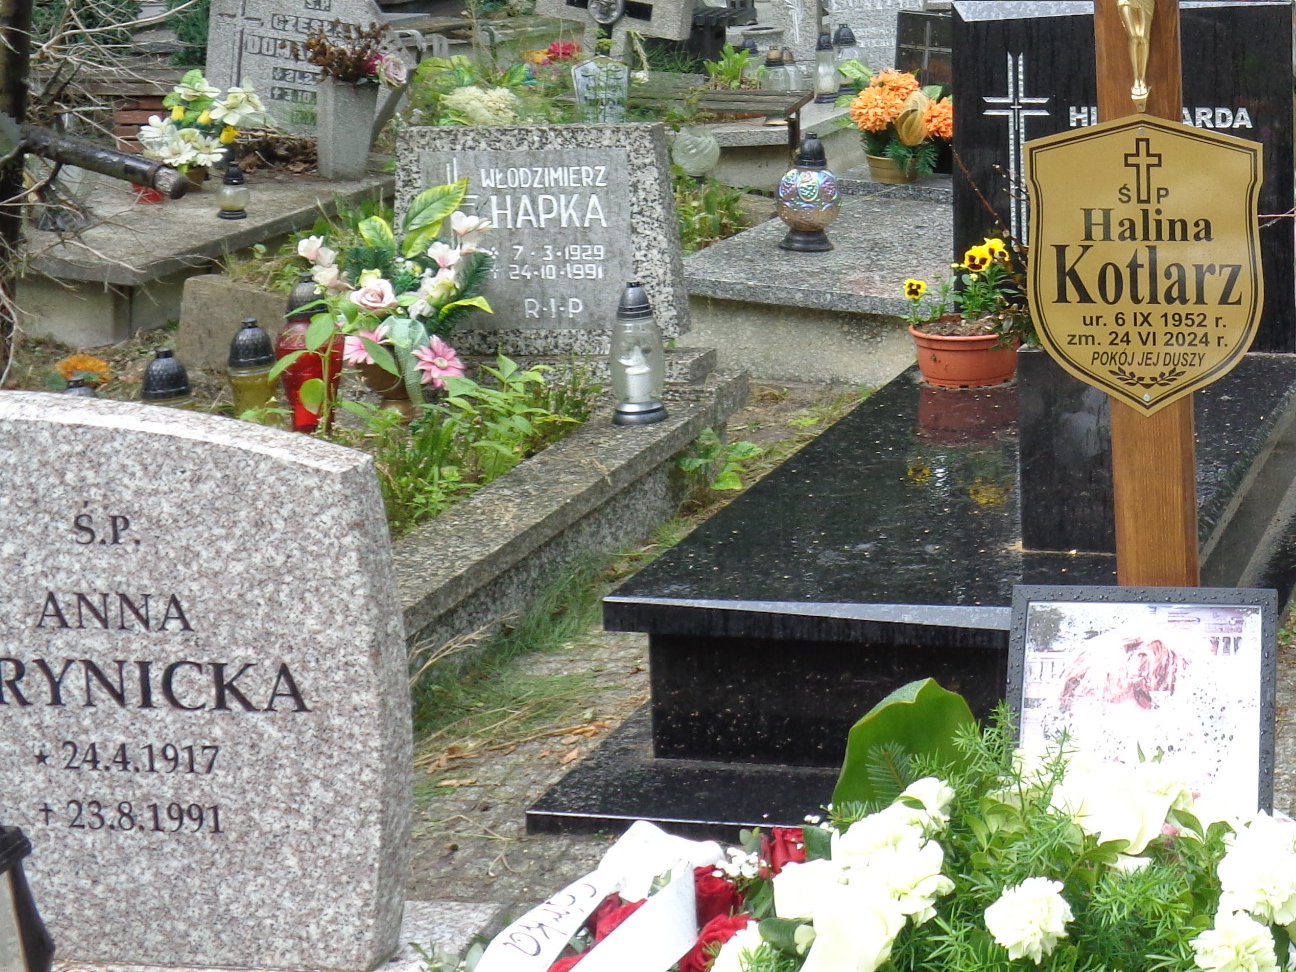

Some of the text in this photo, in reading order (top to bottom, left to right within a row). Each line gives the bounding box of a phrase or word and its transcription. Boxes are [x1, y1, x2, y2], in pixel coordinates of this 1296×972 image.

[480, 165, 607, 188] WŁODZIMIERZ
[490, 193, 607, 229] HAPKA
[1156, 187, 1170, 204] P
[1079, 207, 1214, 242] Halina
[1050, 244, 1243, 306] Kotlarz
[1082, 311, 1227, 328] ur. 6 IX 1952 r.
[1067, 331, 1228, 348] zm. 24 VI 2024 r.
[1091, 349, 1206, 368] POKÓJ JEJ DUSZY
[36, 590, 195, 632] ANNA
[0, 657, 313, 713] RYNICKA
[62, 740, 220, 775] 24.4.1917
[66, 799, 225, 834] 23.8.1991
